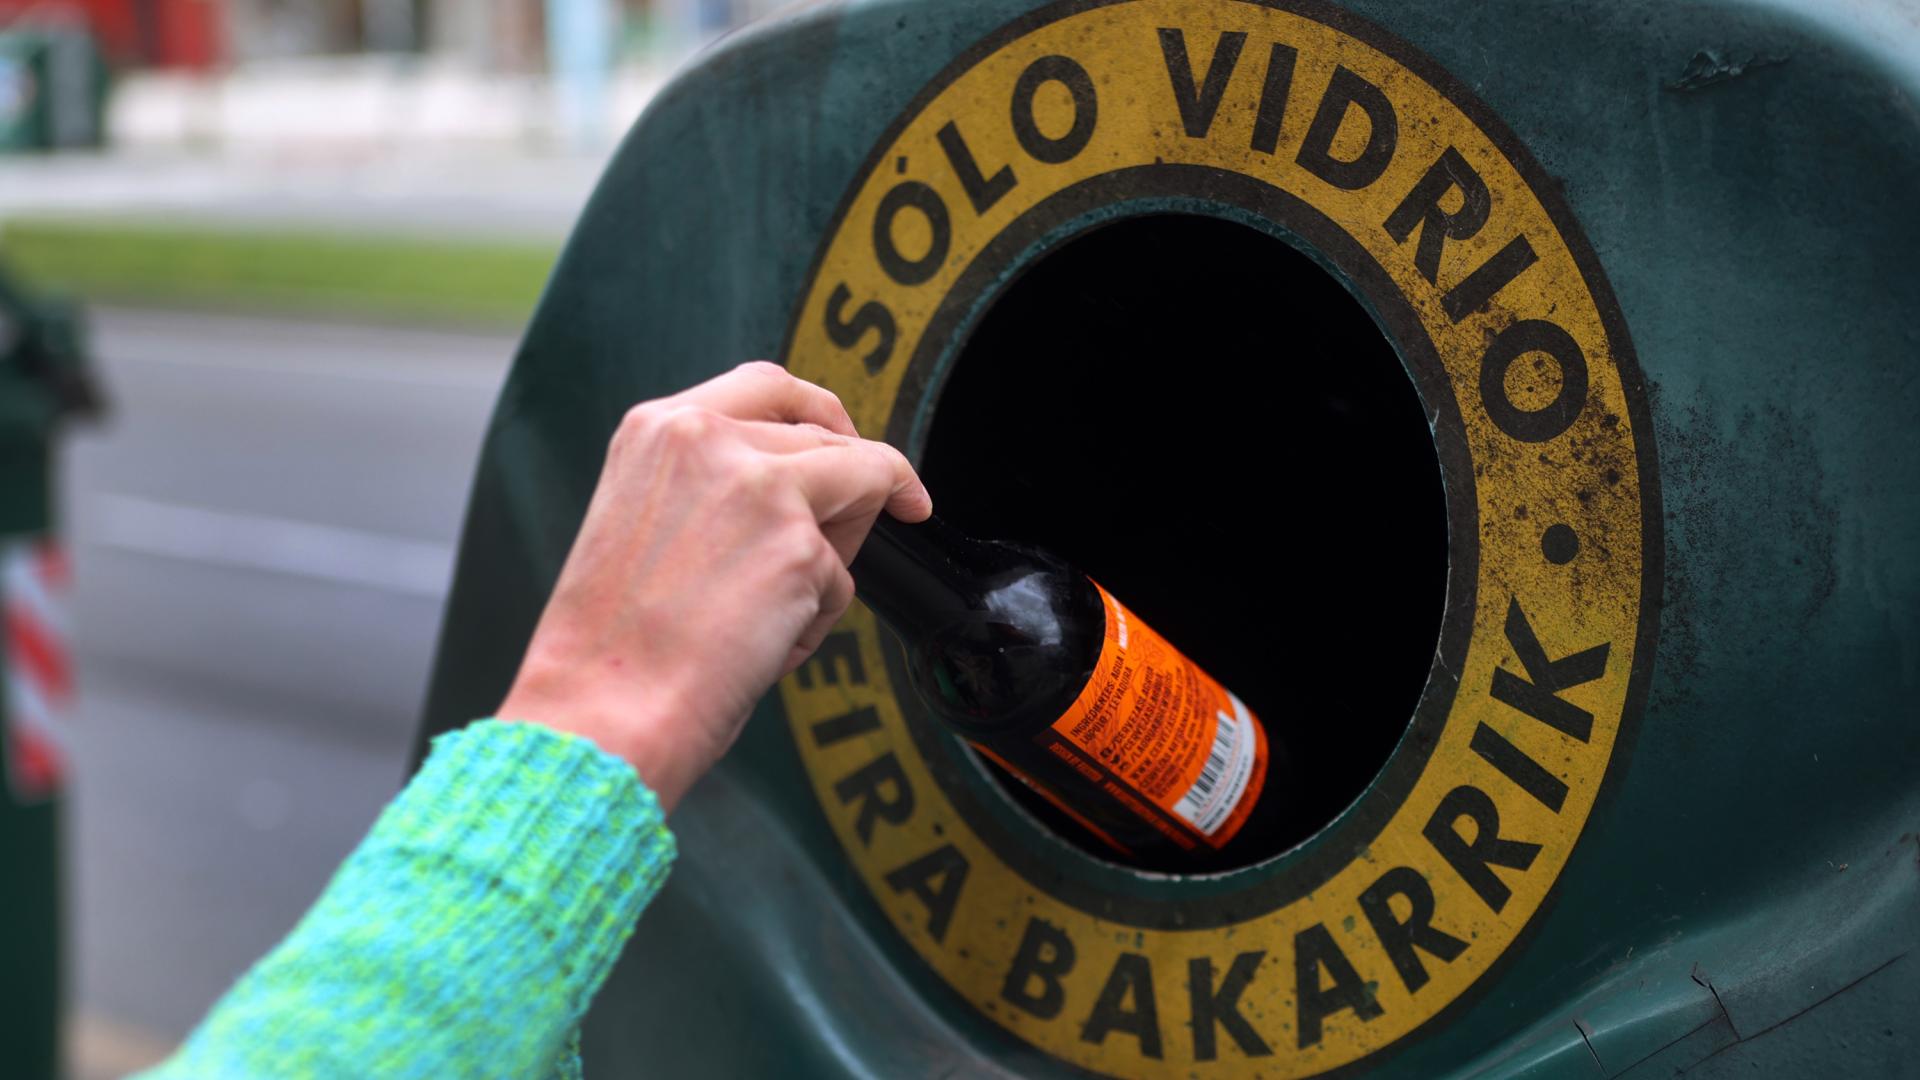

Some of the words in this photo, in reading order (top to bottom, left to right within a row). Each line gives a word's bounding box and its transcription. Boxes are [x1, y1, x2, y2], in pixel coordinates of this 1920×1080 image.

[825, 56, 1097, 373] SÓLO
[1158, 28, 1590, 442] VIDRIO
[794, 630, 972, 945] EIRA
[997, 596, 1611, 1062] BAKARRIK
